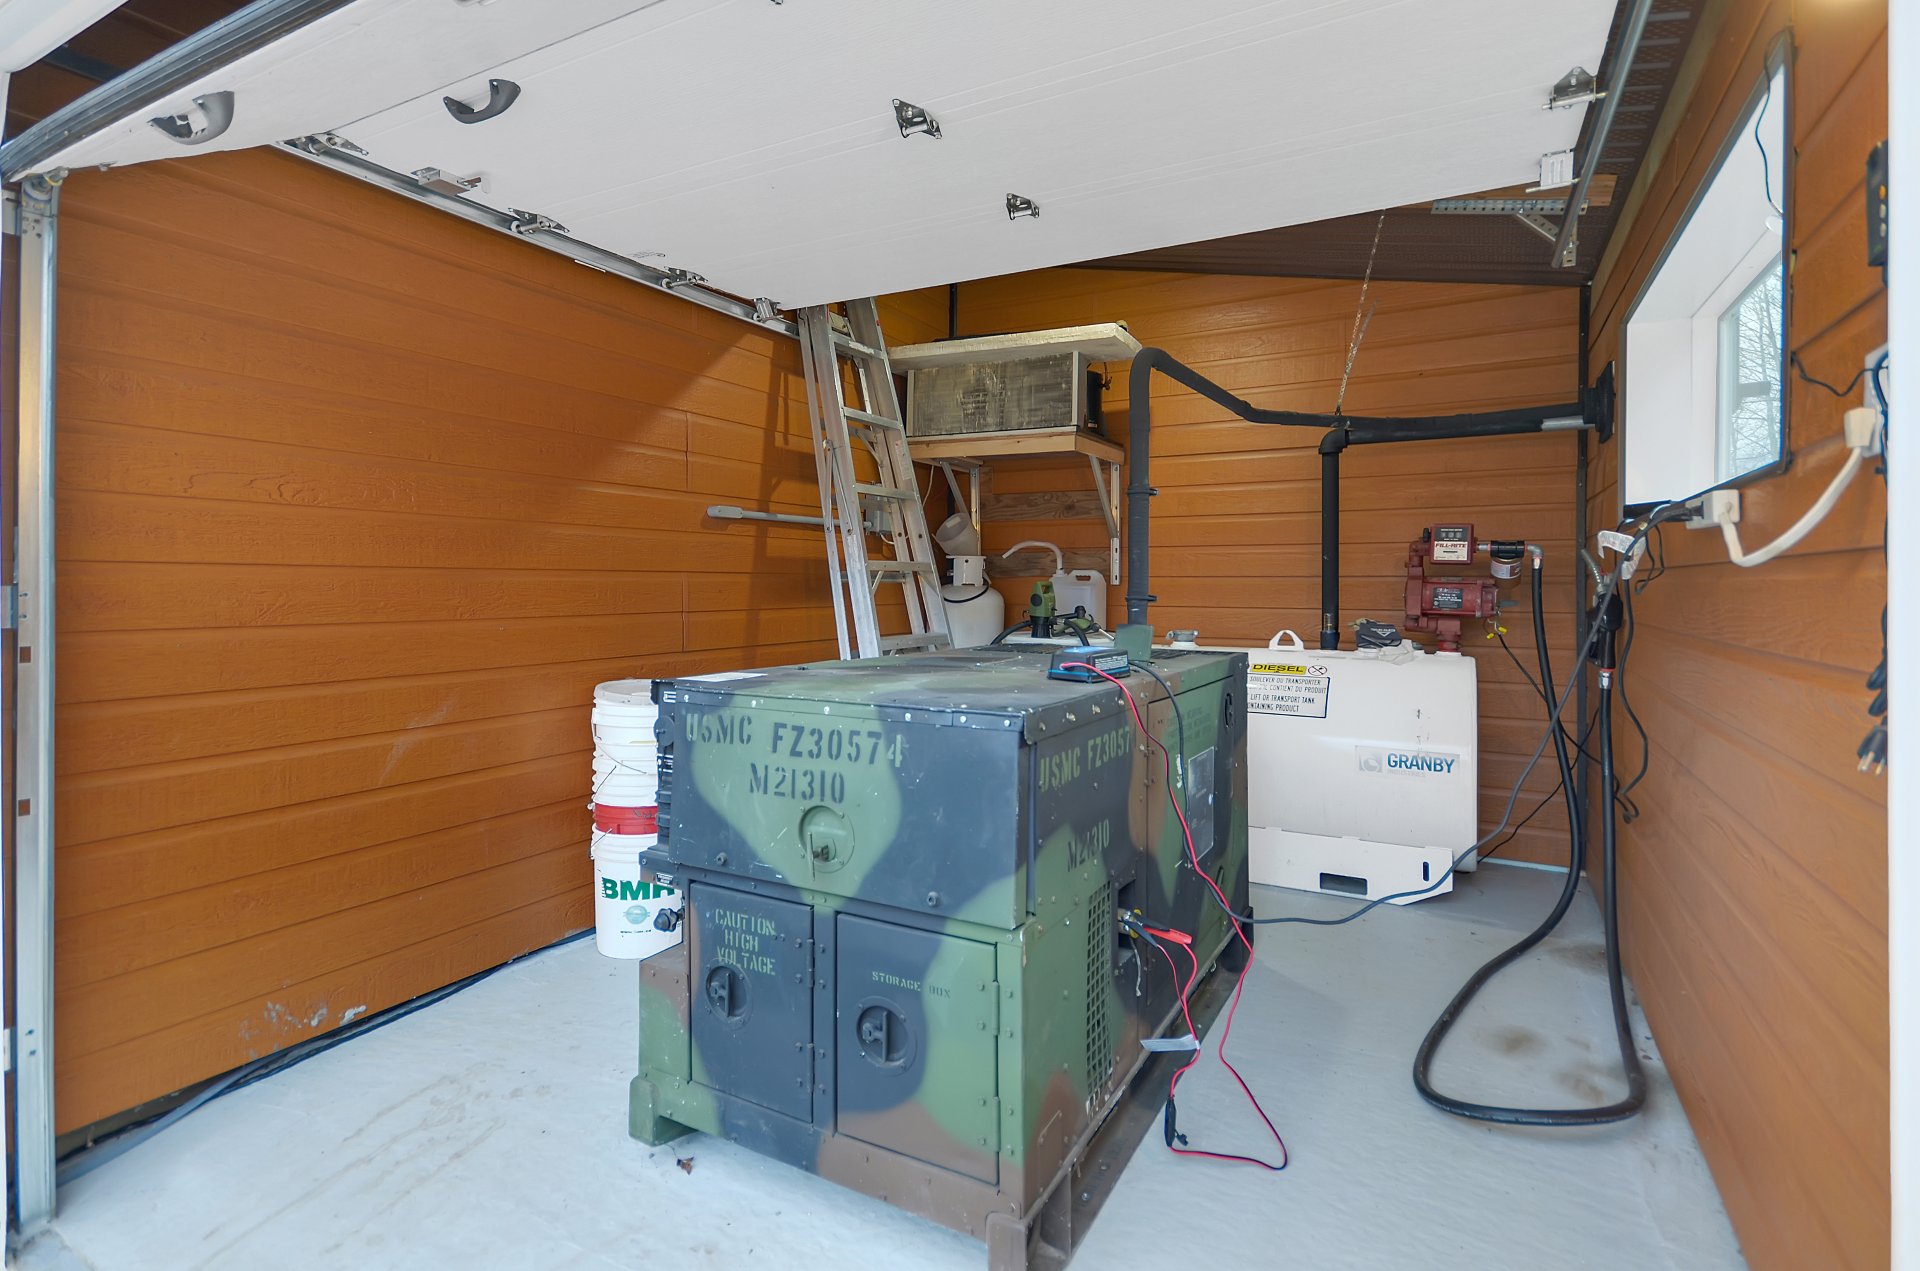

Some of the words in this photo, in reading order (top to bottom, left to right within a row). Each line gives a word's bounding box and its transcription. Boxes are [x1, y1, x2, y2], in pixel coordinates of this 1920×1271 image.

[1253, 664, 1304, 672] DIESEL
[1250, 693, 1261, 701] LIFT
[1271, 695, 1300, 703] TRANSPORT
[1301, 696, 1315, 704] TANK
[1275, 704, 1299, 712] PRODUCT
[686, 713, 752, 745] USMC
[771, 722, 903, 768] FZ30574
[1039, 747, 1081, 793] USMC
[1387, 753, 1455, 773] GRANBY
[749, 763, 845, 804] M21310
[715, 908, 776, 936] CAUTION
[724, 929, 759, 952] HIGH
[717, 946, 776, 976] VOLTAGE
[872, 971, 921, 992] STORAGE
